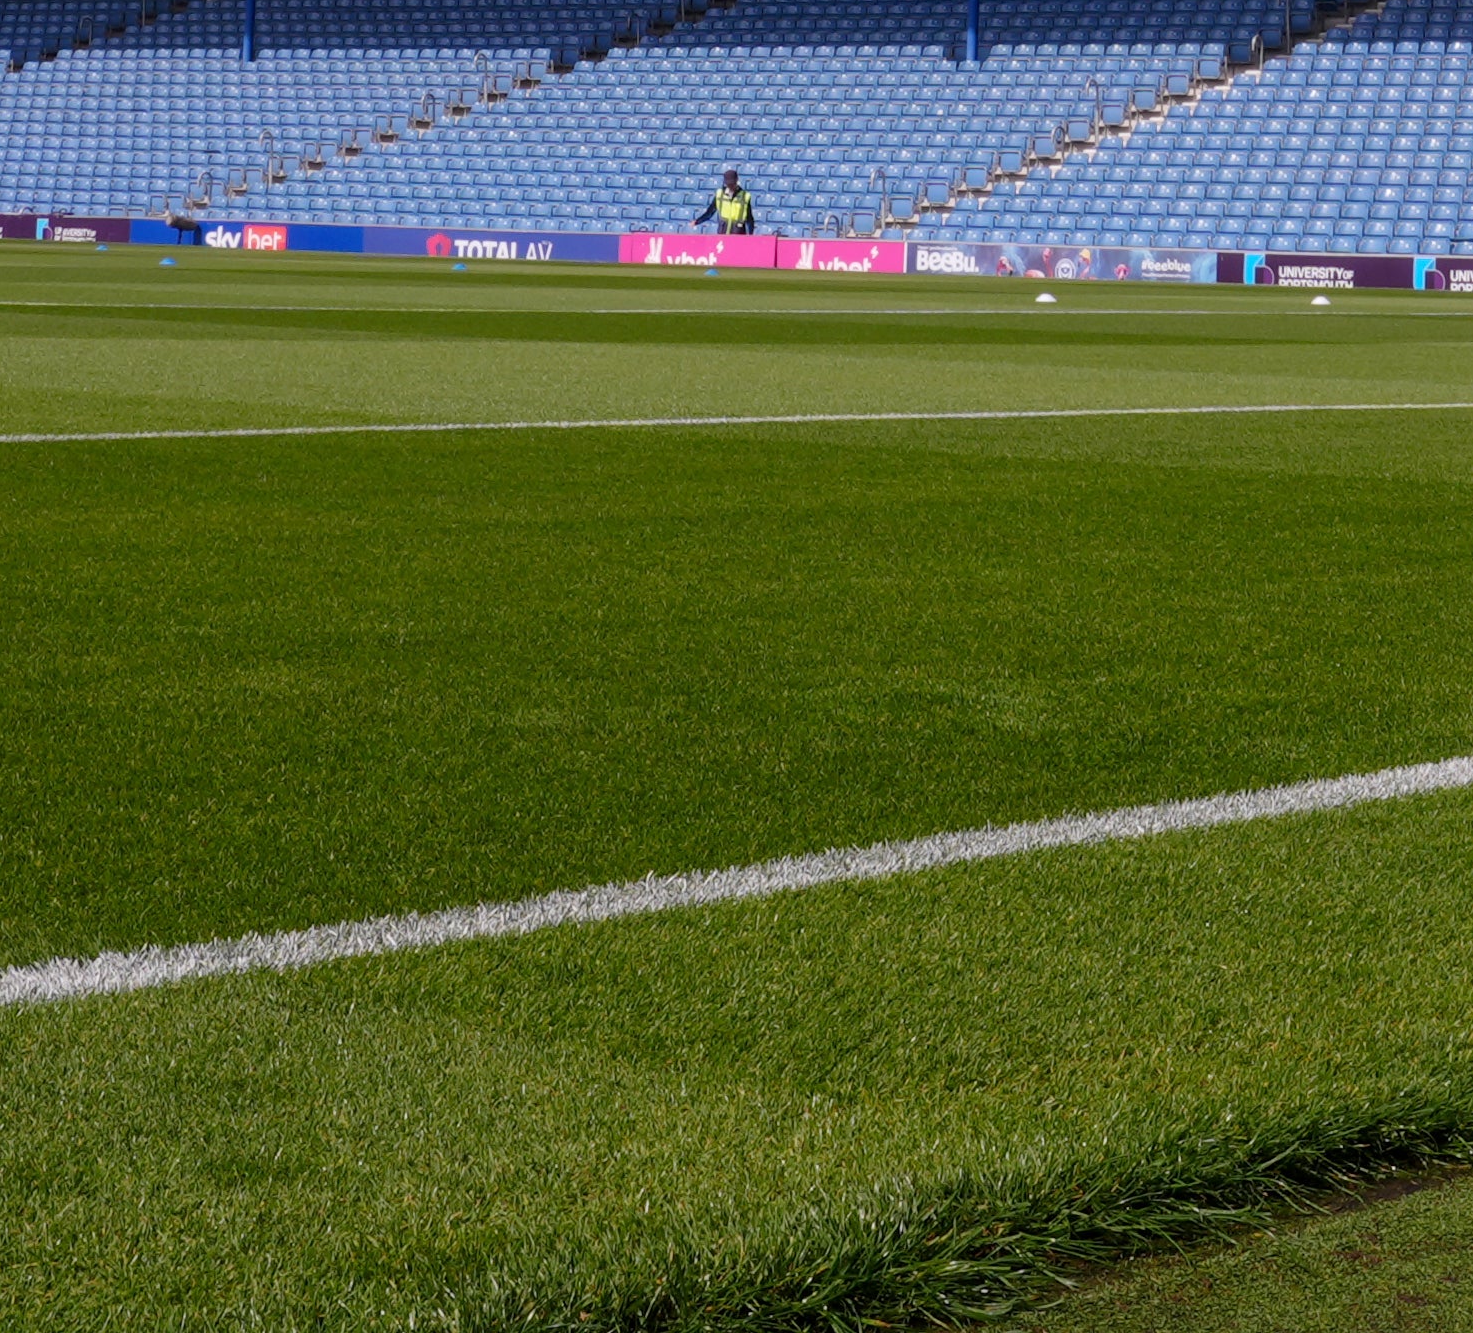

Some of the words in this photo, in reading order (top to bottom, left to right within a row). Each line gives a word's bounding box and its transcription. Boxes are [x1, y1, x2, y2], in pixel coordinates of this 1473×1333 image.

[205, 225, 242, 248] sky
[247, 228, 282, 250] bet
[916, 250, 980, 273] BeeBu.
[1278, 266, 1343, 279] UNIVERSITY
